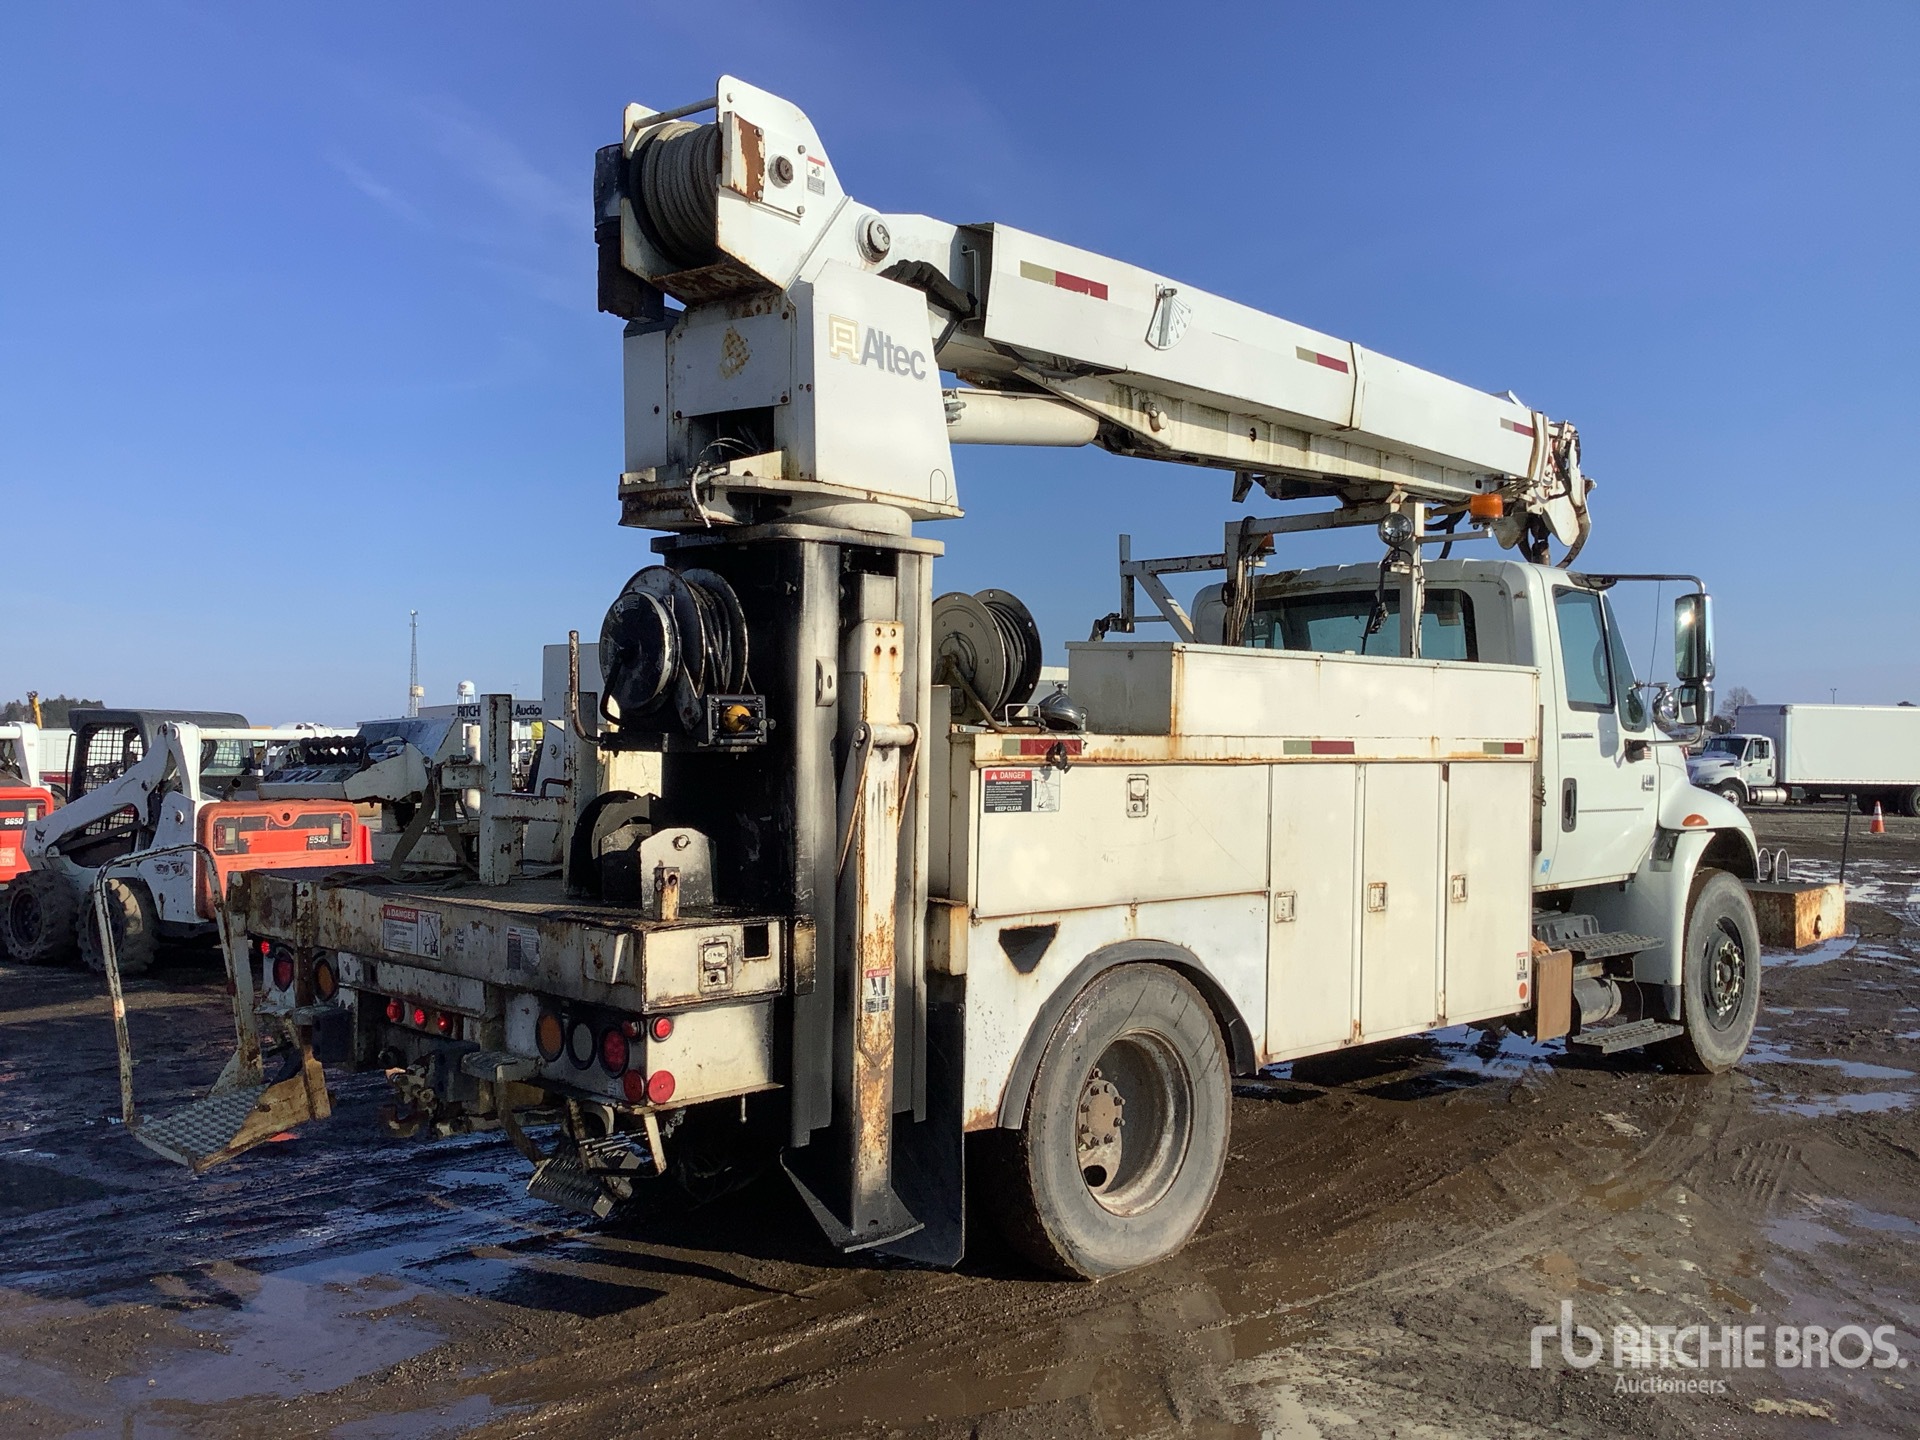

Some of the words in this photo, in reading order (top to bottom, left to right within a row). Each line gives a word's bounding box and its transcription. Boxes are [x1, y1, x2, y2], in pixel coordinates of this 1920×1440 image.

[861, 327, 926, 380] Altec
[457, 705, 480, 717] RITCH
[1000, 771, 1026, 779] DANGER
[391, 908, 416, 920] DANGER
